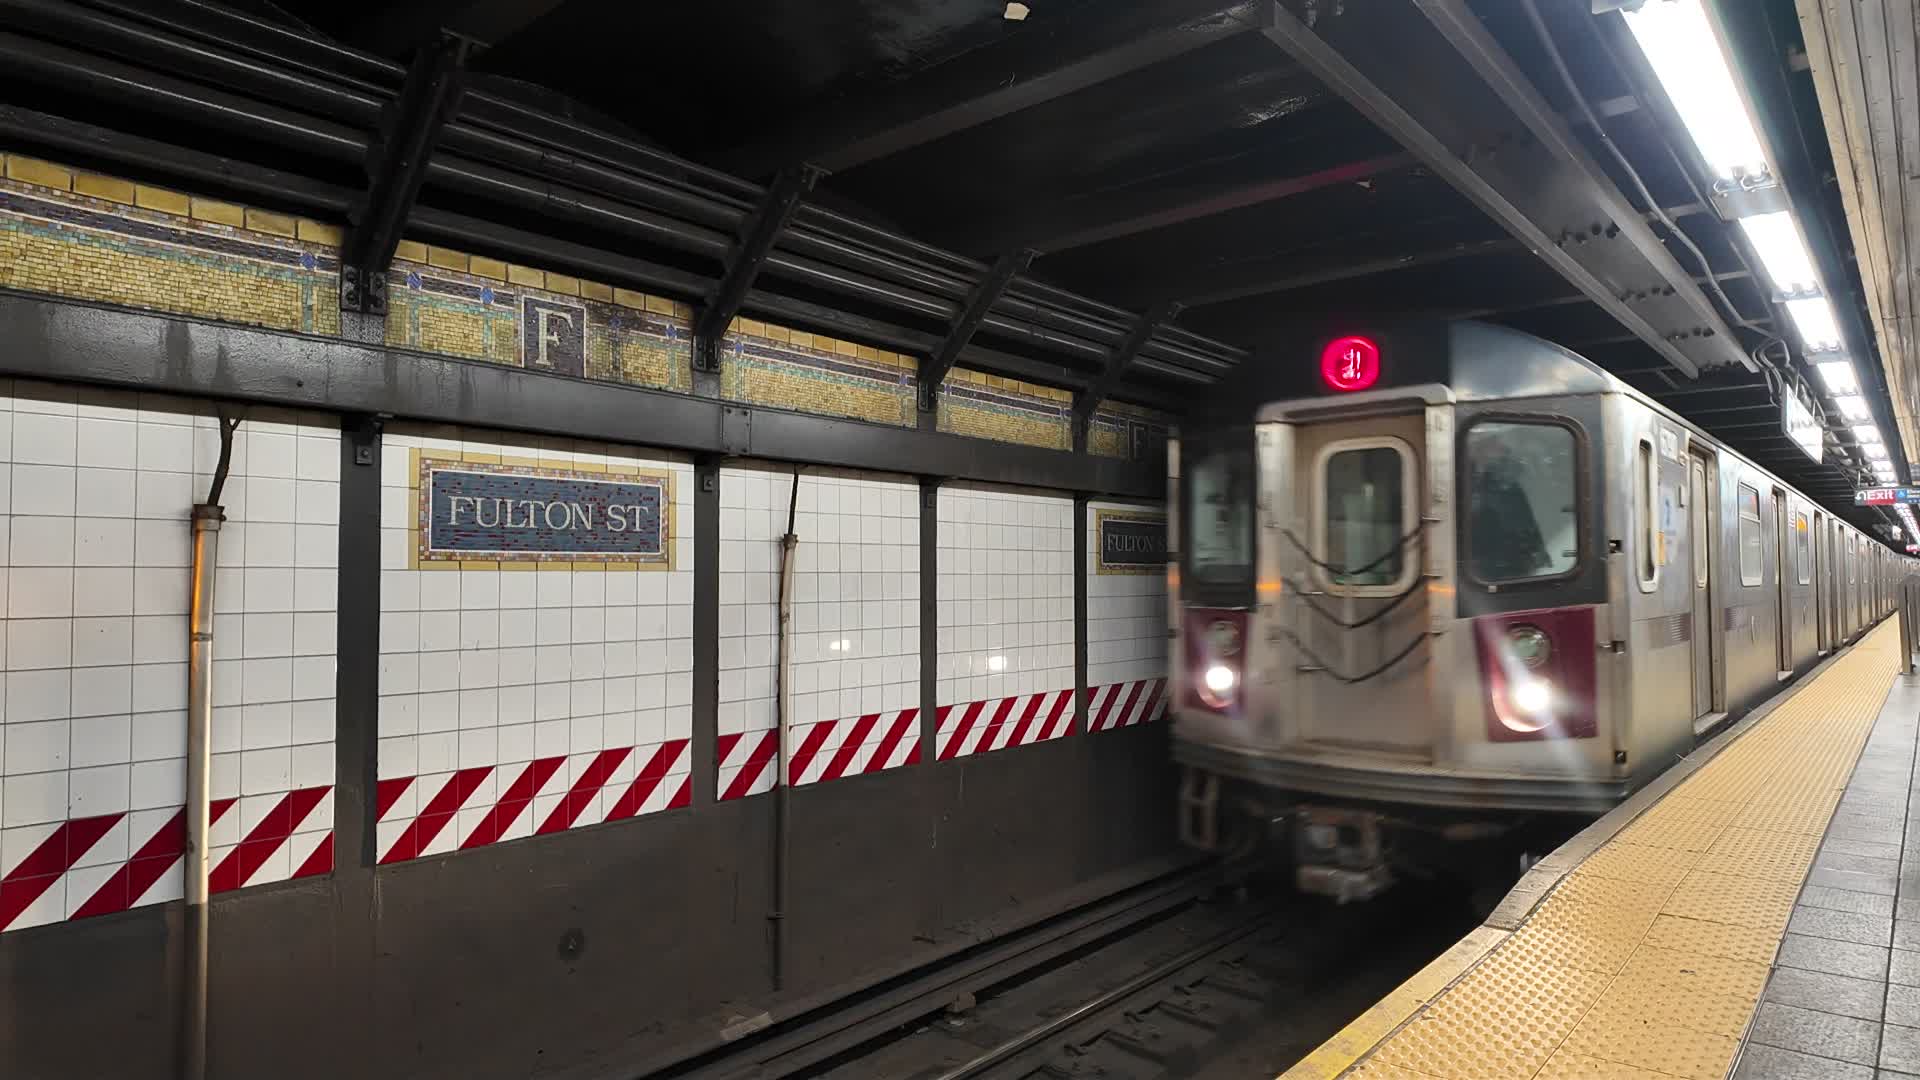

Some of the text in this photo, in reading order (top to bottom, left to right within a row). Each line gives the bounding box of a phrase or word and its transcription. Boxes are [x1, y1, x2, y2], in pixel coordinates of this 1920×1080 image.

[535, 306, 574, 366] F
[1867, 489, 1894, 500] Exit
[447, 495, 650, 532] FULTON ST
[1106, 533, 1153, 553] FULTON
